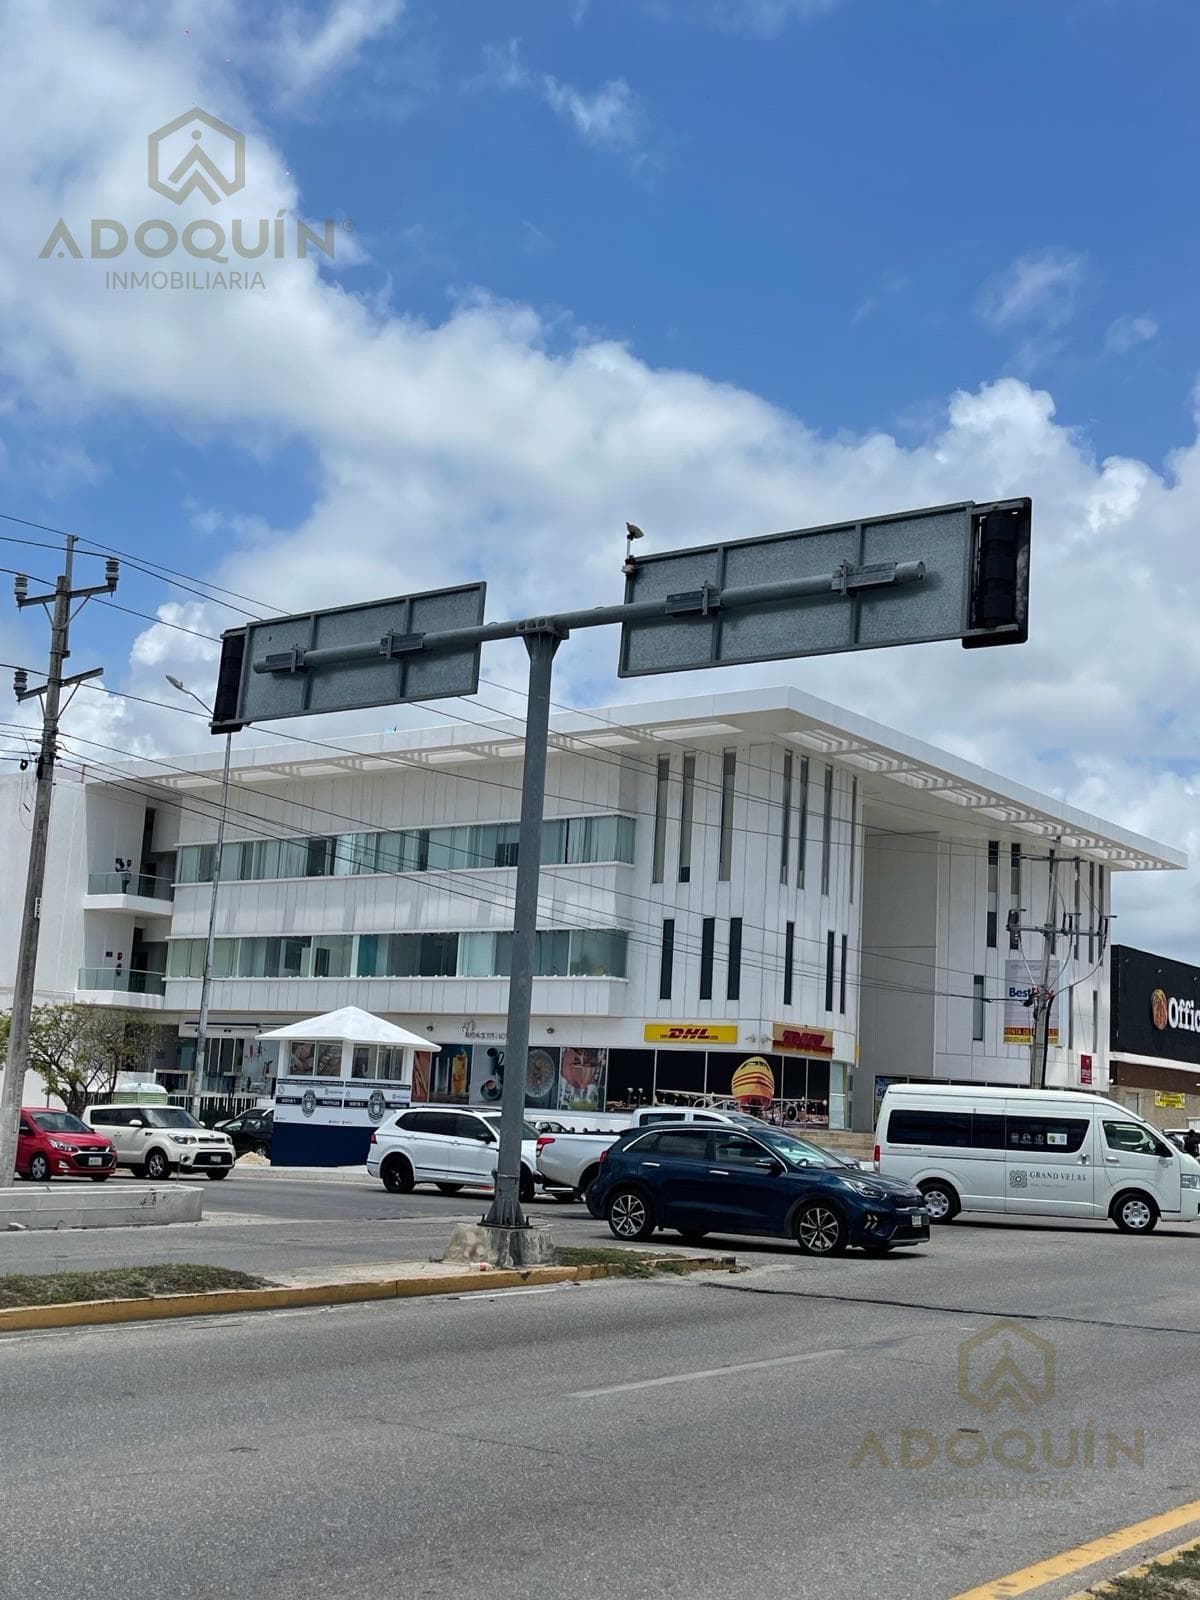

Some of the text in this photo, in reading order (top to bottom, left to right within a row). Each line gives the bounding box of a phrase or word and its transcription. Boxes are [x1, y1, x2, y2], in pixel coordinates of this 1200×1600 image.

[667, 1027, 711, 1040] DHL
[782, 1030, 826, 1050] DHL
[1029, 1170, 1059, 1180] GRAND
